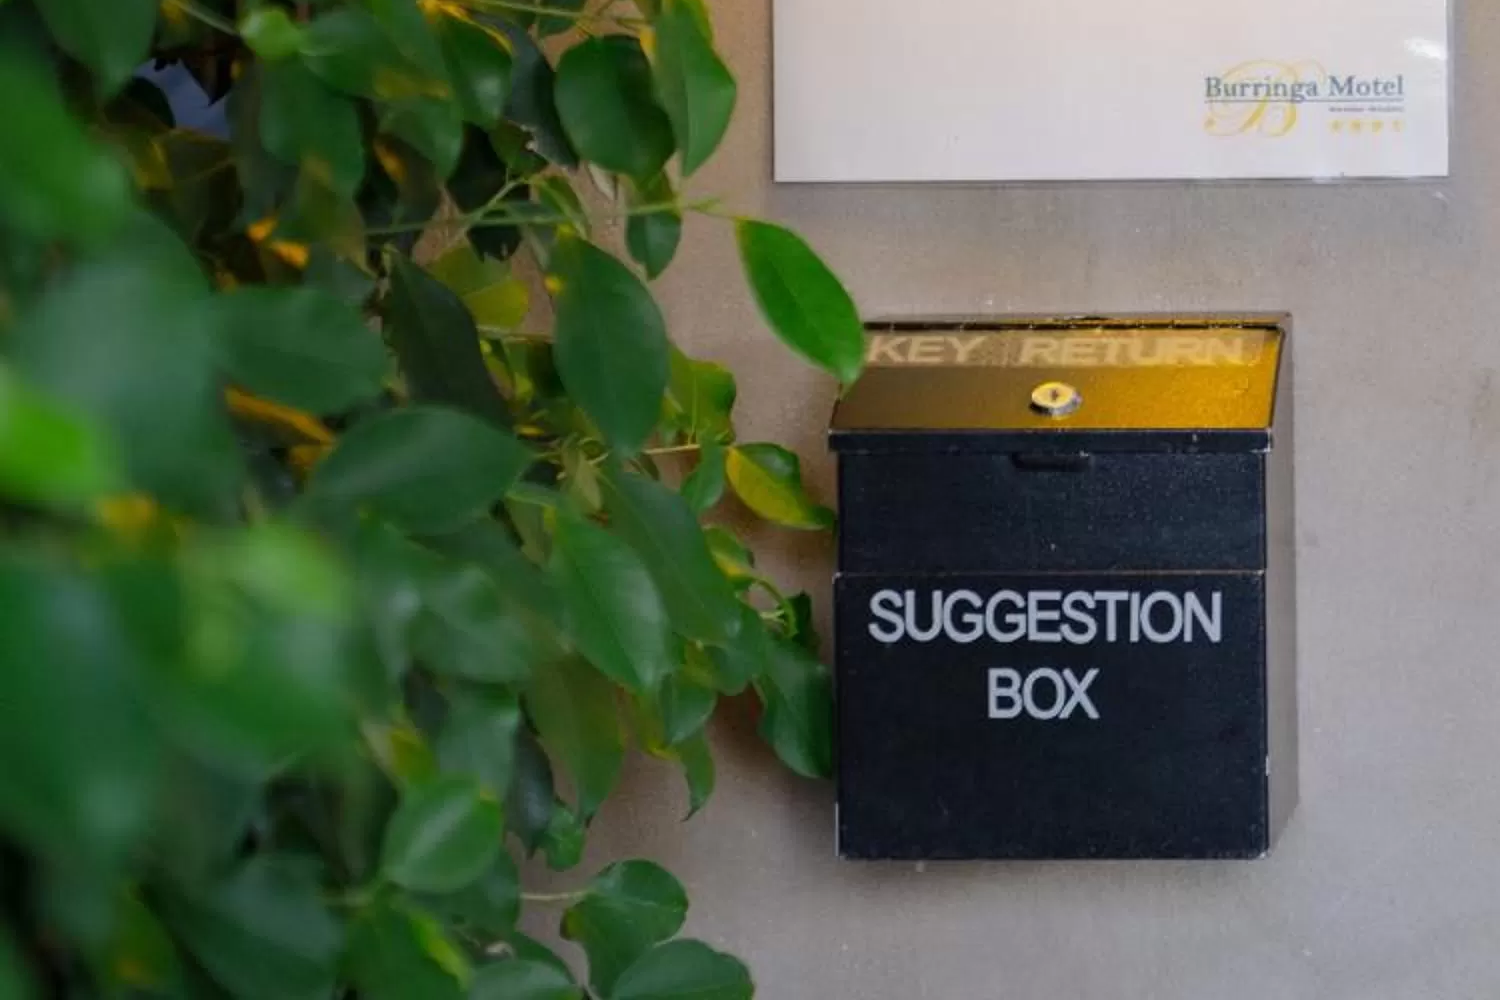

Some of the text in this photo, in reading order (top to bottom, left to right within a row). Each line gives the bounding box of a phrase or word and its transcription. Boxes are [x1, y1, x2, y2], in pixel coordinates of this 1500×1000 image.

[1204, 74, 1405, 102] Burringa Motel
[867, 336, 1243, 366] KEY RETURN
[868, 588, 1222, 643] SUGGESTION
[987, 668, 1100, 720] BOX
